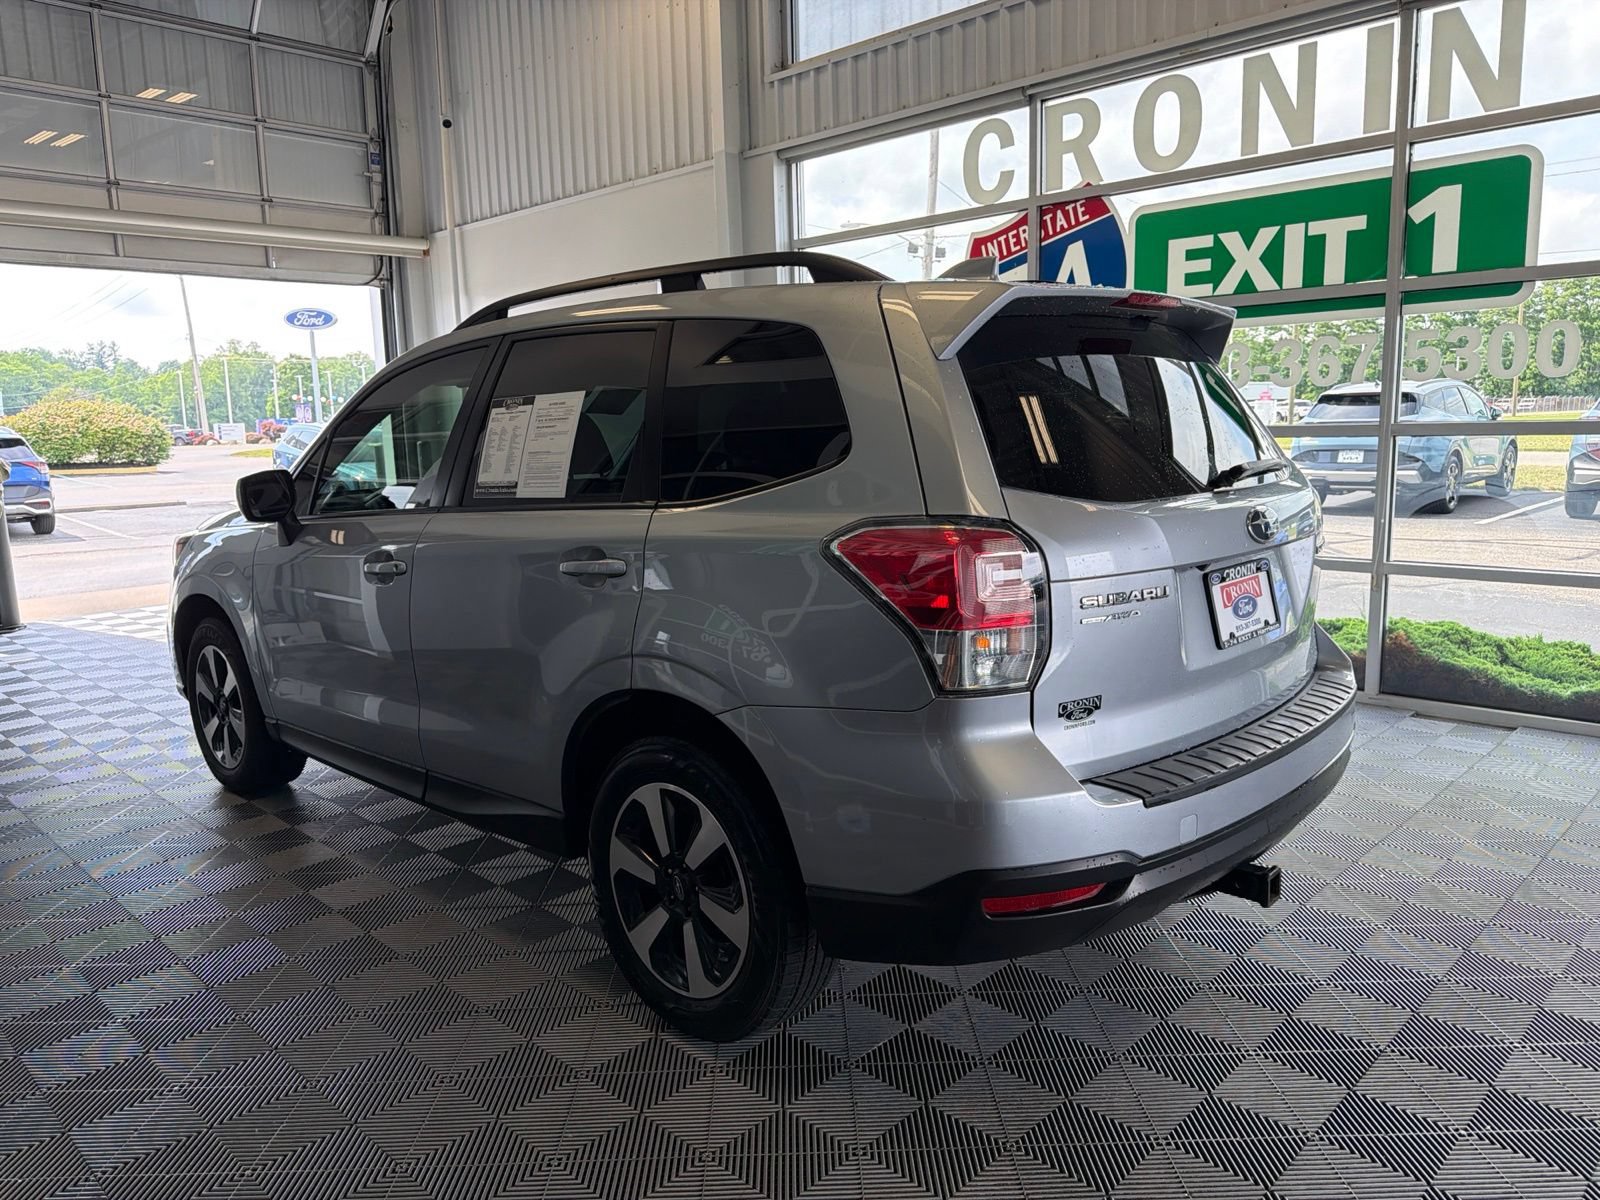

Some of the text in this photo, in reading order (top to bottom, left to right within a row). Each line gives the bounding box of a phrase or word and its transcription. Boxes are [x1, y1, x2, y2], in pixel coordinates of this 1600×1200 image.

[962, 0, 1527, 206] CRONIN
[981, 200, 1090, 258] INTERTATE
[1166, 184, 1463, 299] EXIT 1
[293, 311, 325, 326] Ford
[1224, 562, 1257, 581] CRONIN
[1080, 585, 1170, 609] SUBARU
[1223, 578, 1261, 606] CRONIN
[1059, 695, 1101, 715] CRONIN
